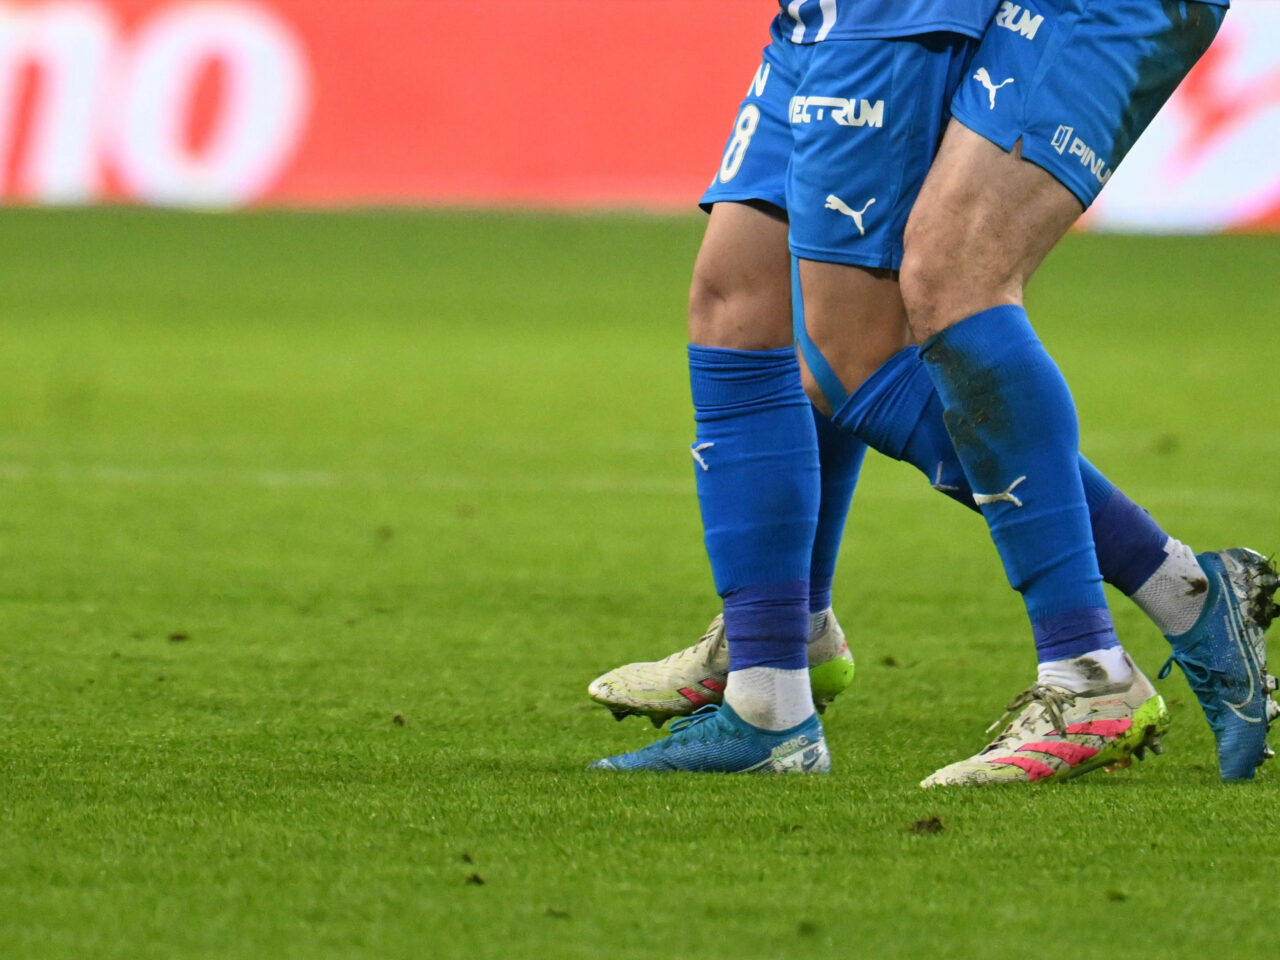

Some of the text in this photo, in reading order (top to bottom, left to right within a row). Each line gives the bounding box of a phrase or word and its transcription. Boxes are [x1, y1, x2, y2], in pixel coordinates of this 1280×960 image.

[789, 95, 885, 128] ECTRUM
[711, 103, 761, 188] 8
[1068, 136, 1113, 186] PINU
